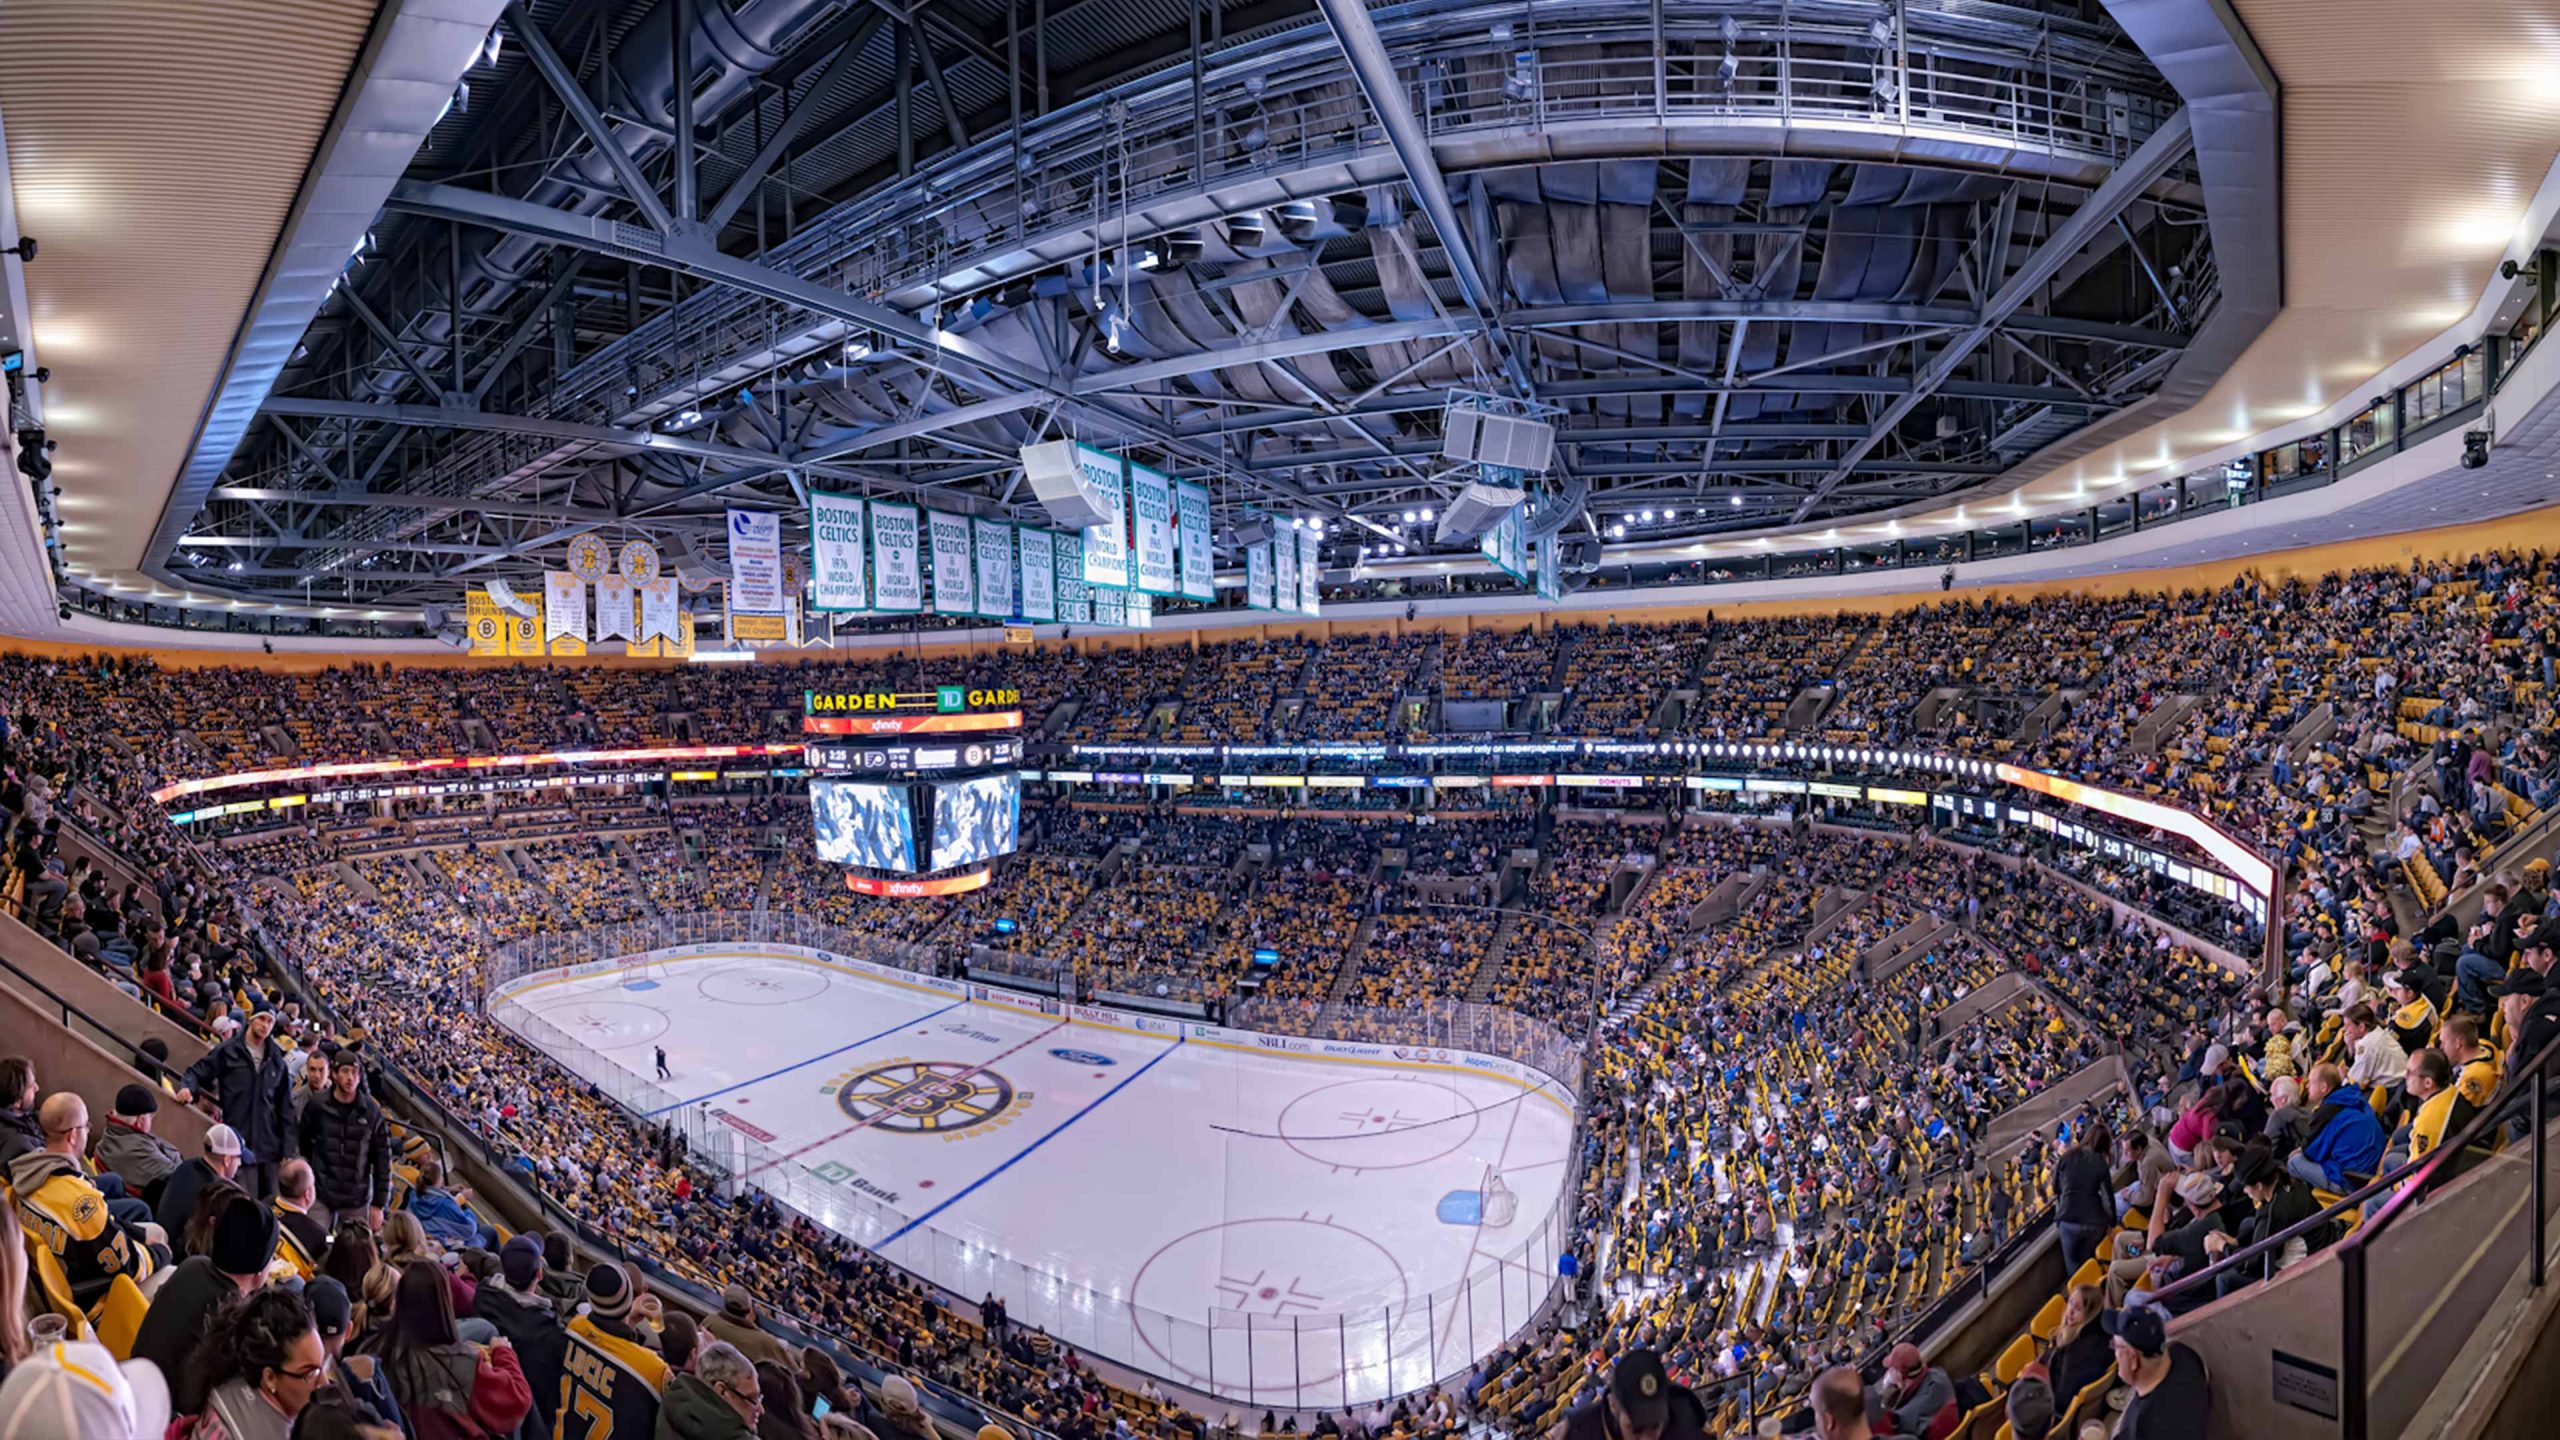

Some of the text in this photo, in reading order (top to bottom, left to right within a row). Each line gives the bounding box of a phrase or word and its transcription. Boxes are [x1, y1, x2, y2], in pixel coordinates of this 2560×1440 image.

[1084, 464, 1119, 491] BOSTON
[1136, 481, 1167, 500] BOSTON
[1139, 501, 1167, 523] CELTICS
[1181, 495, 1207, 515] BOSTON
[817, 507, 859, 526] BOSTON
[876, 515, 914, 532] BOSTON
[1183, 514, 1208, 533] CELTICS
[819, 525, 858, 543] CELTICS
[933, 522, 966, 539] BOSTON
[978, 530, 1008, 546] BOSTON
[878, 532, 914, 548] CELTICS
[936, 539, 966, 555] CELTICS
[1023, 537, 1050, 554] BOSTON
[1056, 535, 1071, 554] 22
[1095, 539, 1117, 555] WORLD
[980, 545, 1008, 561] CELTICS
[1024, 553, 1049, 569] CELTICS
[1058, 558, 1071, 576] 23
[1088, 553, 1127, 570] CHAMPIONS
[827, 572, 855, 584] WORLD
[886, 575, 910, 586] WORLD
[943, 580, 964, 590] WORLD
[819, 584, 862, 597] CHAMPIONS
[880, 587, 918, 598] CHAMPIONS
[1059, 580, 1089, 600] 21 25
[468, 596, 495, 606] BOST
[468, 606, 504, 617] BRUINS
[1060, 603, 1087, 621] 24 6
[1097, 606, 1121, 623] 10 2
[814, 694, 896, 710] GARDEN
[941, 691, 961, 707] TD
[872, 720, 903, 731] xfinity
[1132, 746, 1145, 756] only
[1291, 747, 1306, 756] only
[1475, 744, 1491, 754] only
[1599, 778, 1631, 786] DONUTS
[889, 883, 923, 895] xfinity
[1074, 1007, 1099, 1018] BULLY
[1101, 1011, 1120, 1022] HILL
[722, 1114, 773, 1142] CHIPOTLE
[821, 1163, 900, 1204] TD Bank
[97, 1230, 130, 1274] 37
[563, 1340, 616, 1399] LUCIC
[552, 1373, 614, 1440] 17
